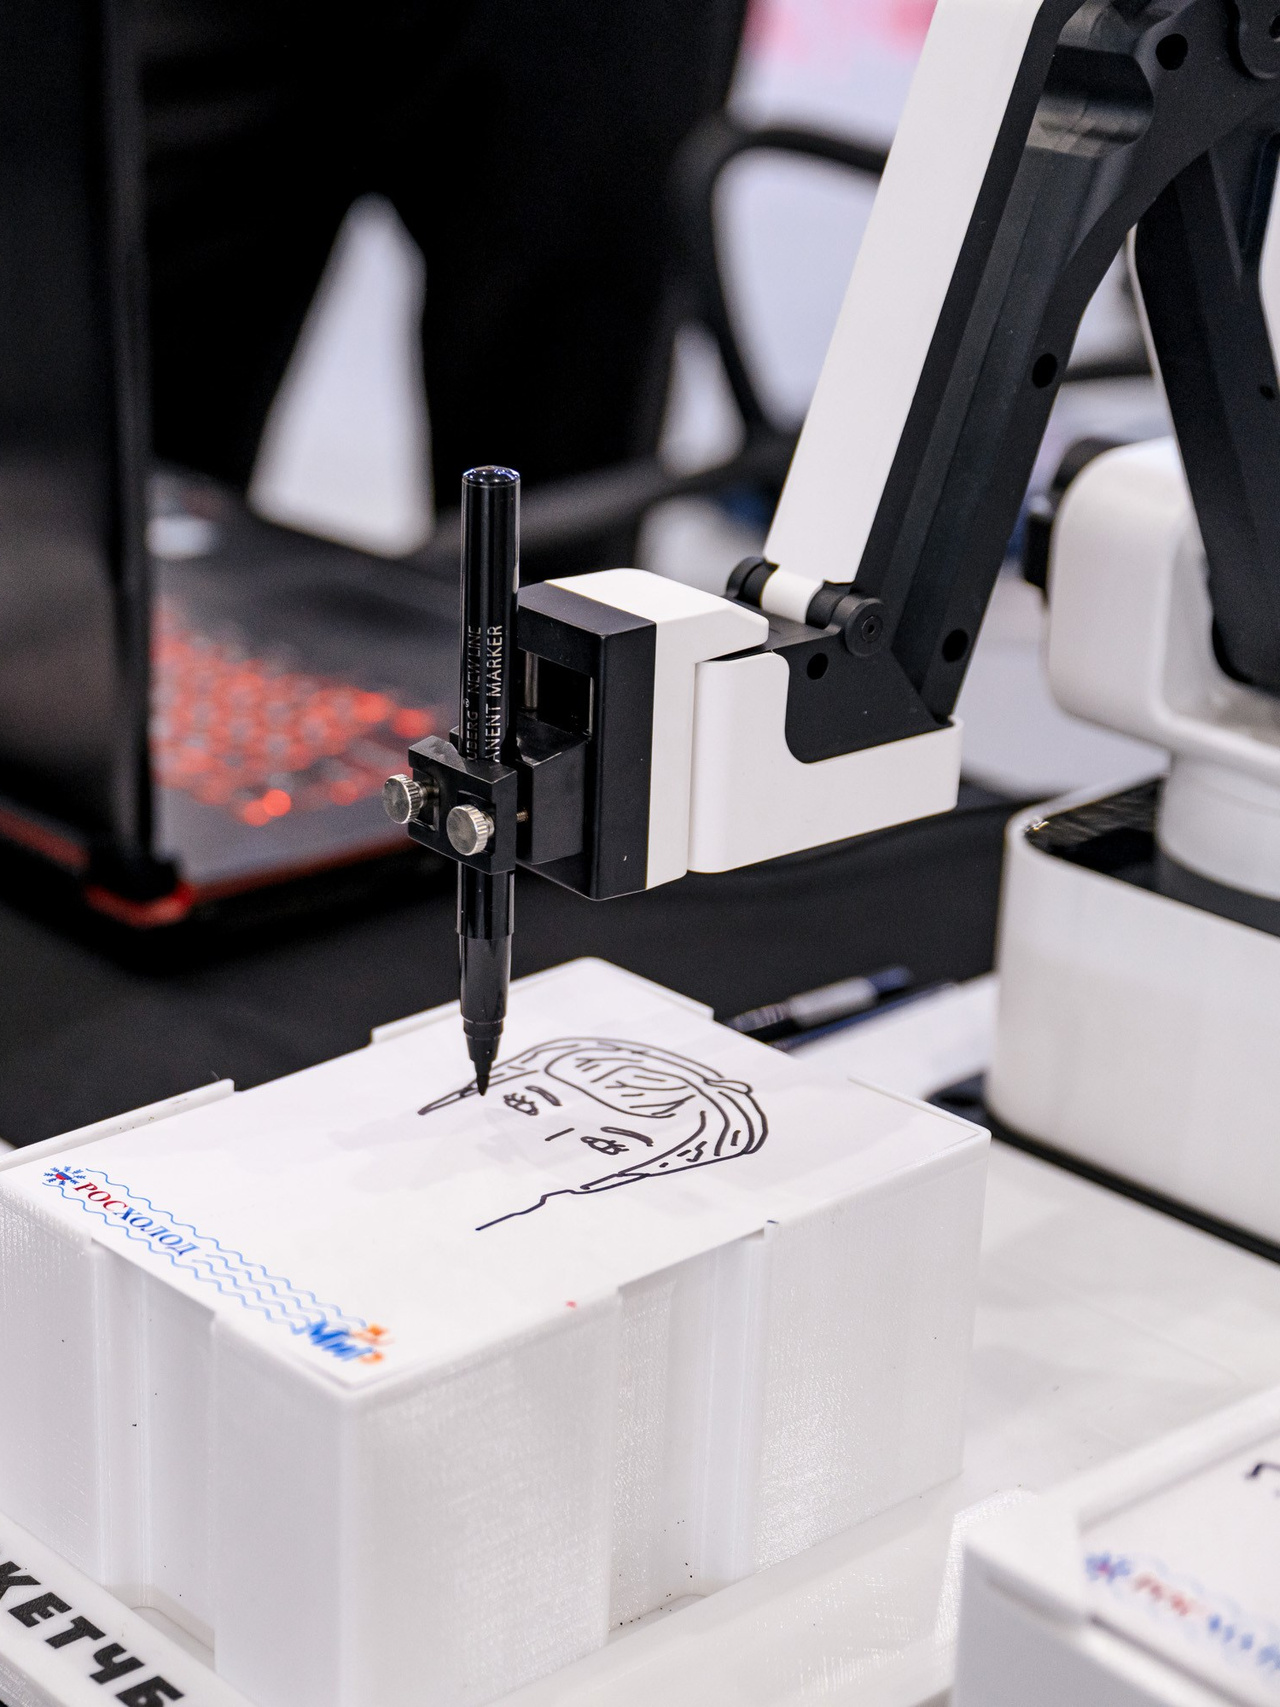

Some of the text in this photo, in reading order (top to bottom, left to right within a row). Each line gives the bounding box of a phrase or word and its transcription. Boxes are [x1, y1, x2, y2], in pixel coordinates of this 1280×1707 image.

[468, 625, 482, 658] LINE
[467, 660, 481, 694] NEW
[484, 625, 503, 763] ANENT MARKER
[73, 1181, 201, 1257] РОСХОЛОД
